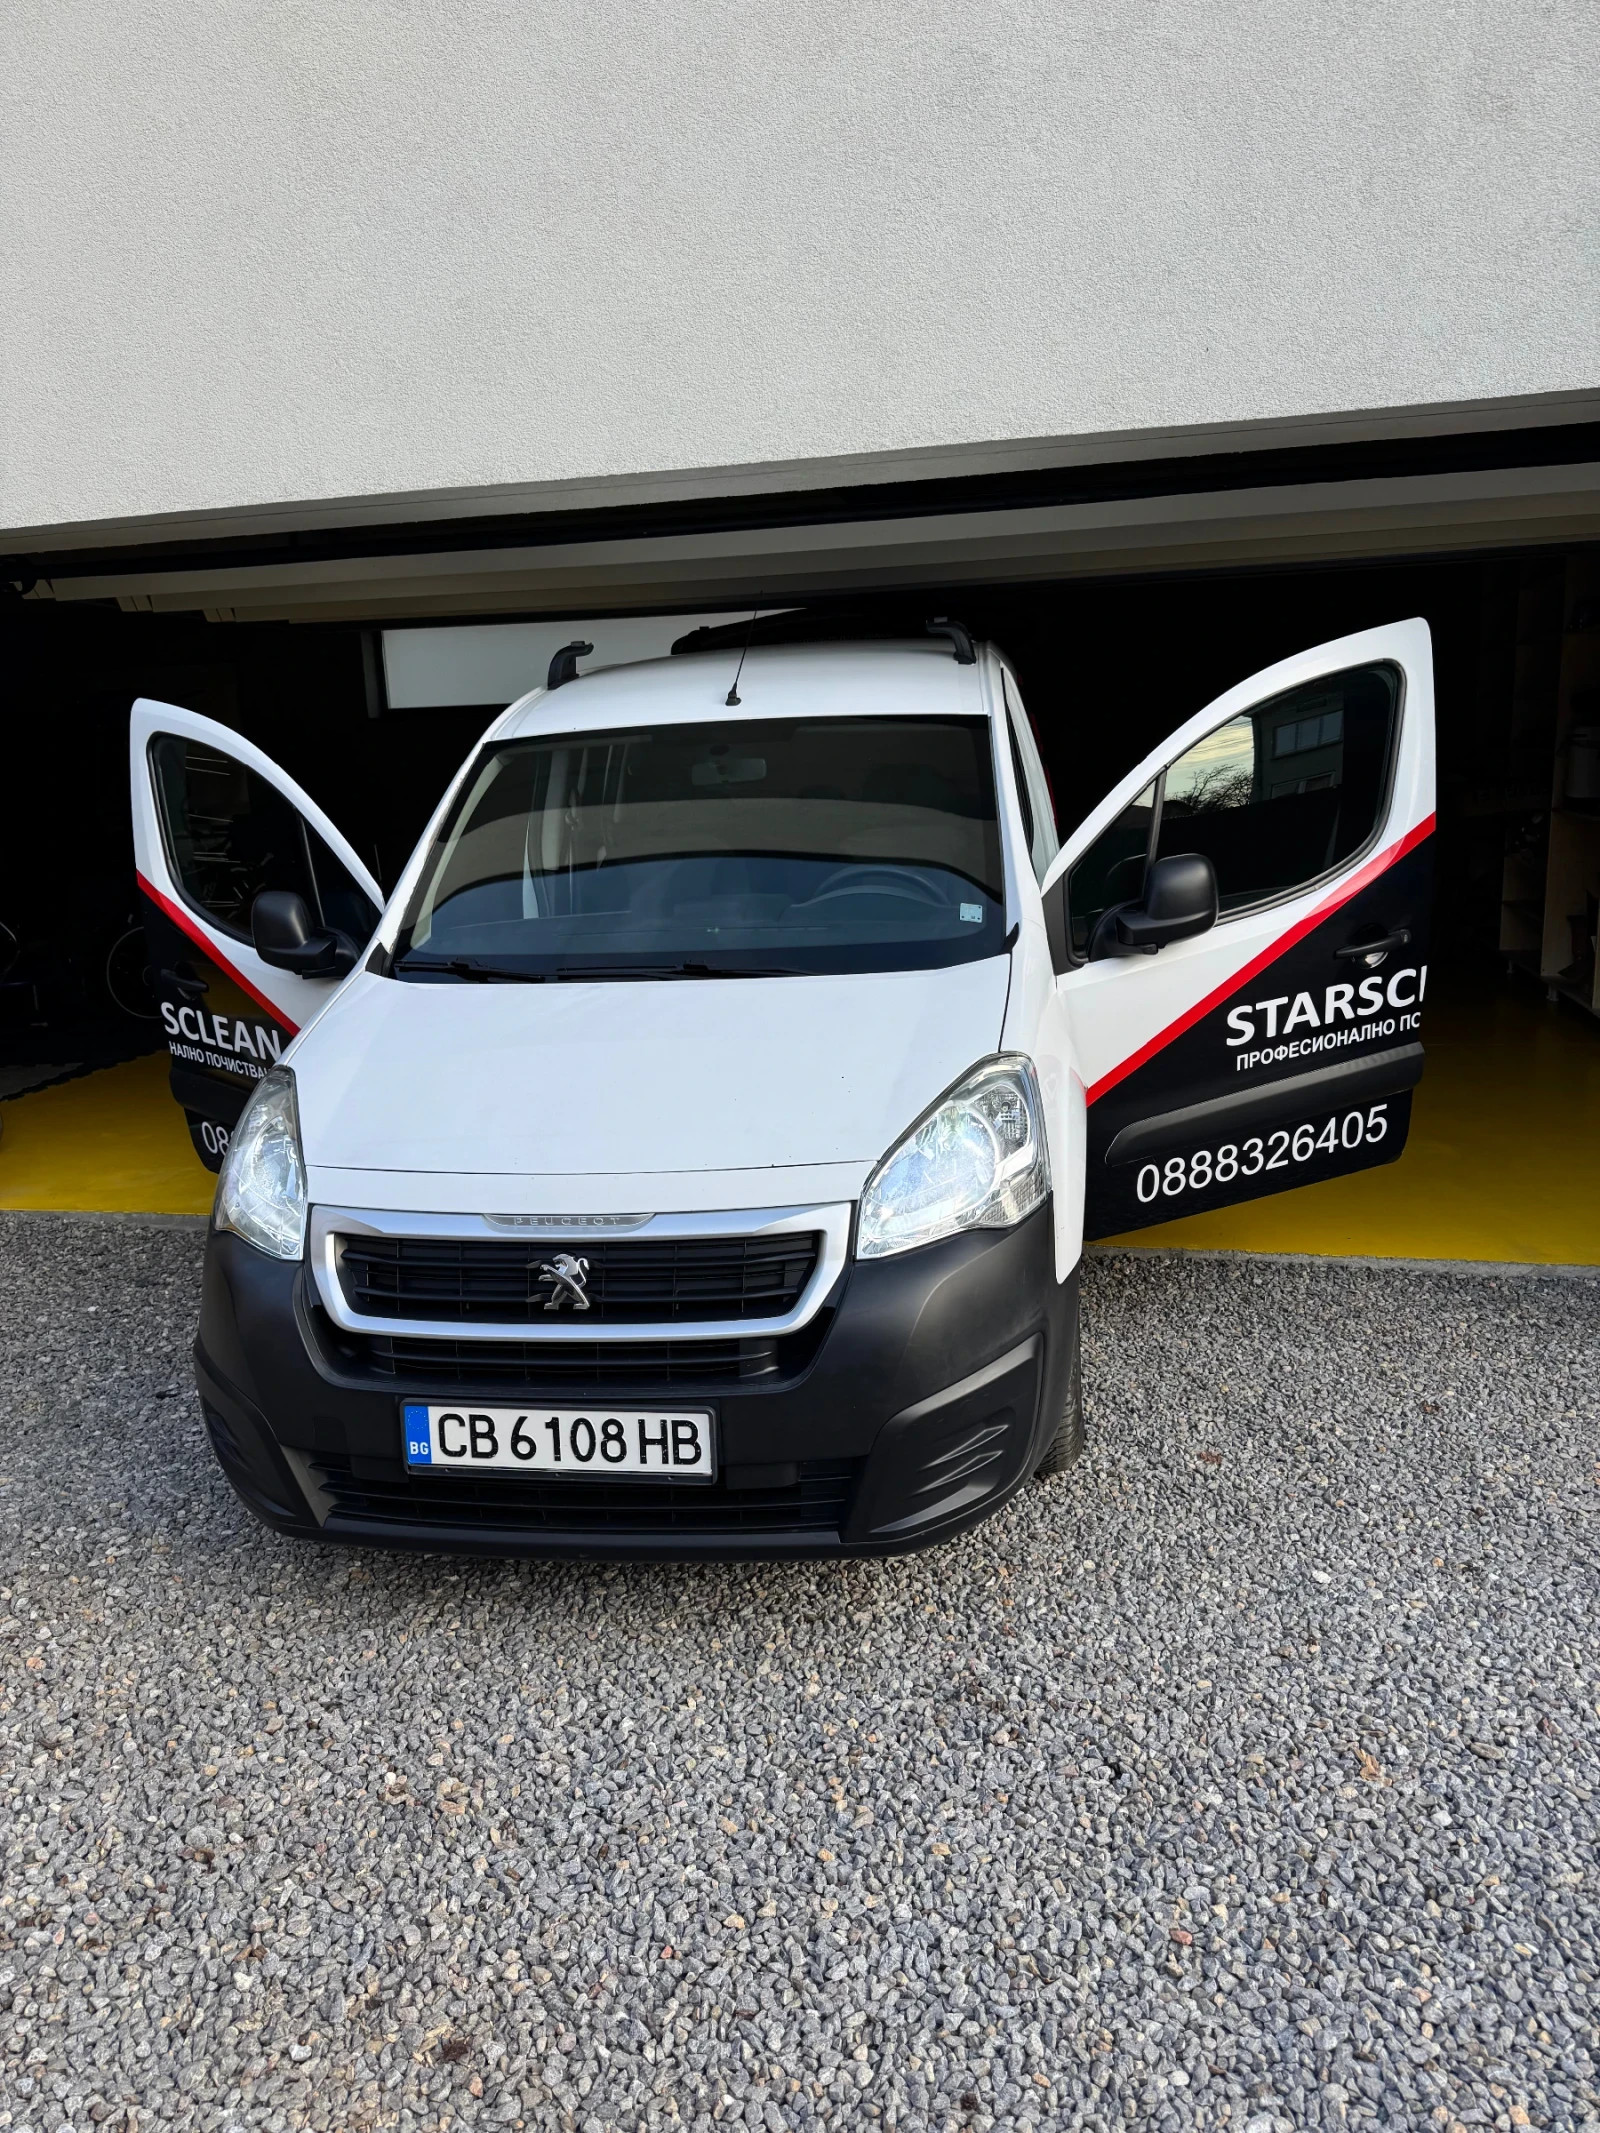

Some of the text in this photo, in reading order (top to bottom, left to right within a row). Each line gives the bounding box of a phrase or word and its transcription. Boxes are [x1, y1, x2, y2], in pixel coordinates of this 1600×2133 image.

[161, 1002, 281, 1062] SCLEAN
[169, 1041, 205, 1062] НАЛНО
[1236, 1018, 1396, 1071] ПРОФЕСИОНАЛНО
[202, 1121, 233, 1156] 08
[1136, 1104, 1388, 1202] 0888326405
[513, 1217, 620, 1226] PEUGEOT
[410, 1441, 429, 1455] BG
[438, 1413, 702, 1465] CB 6108 HB
